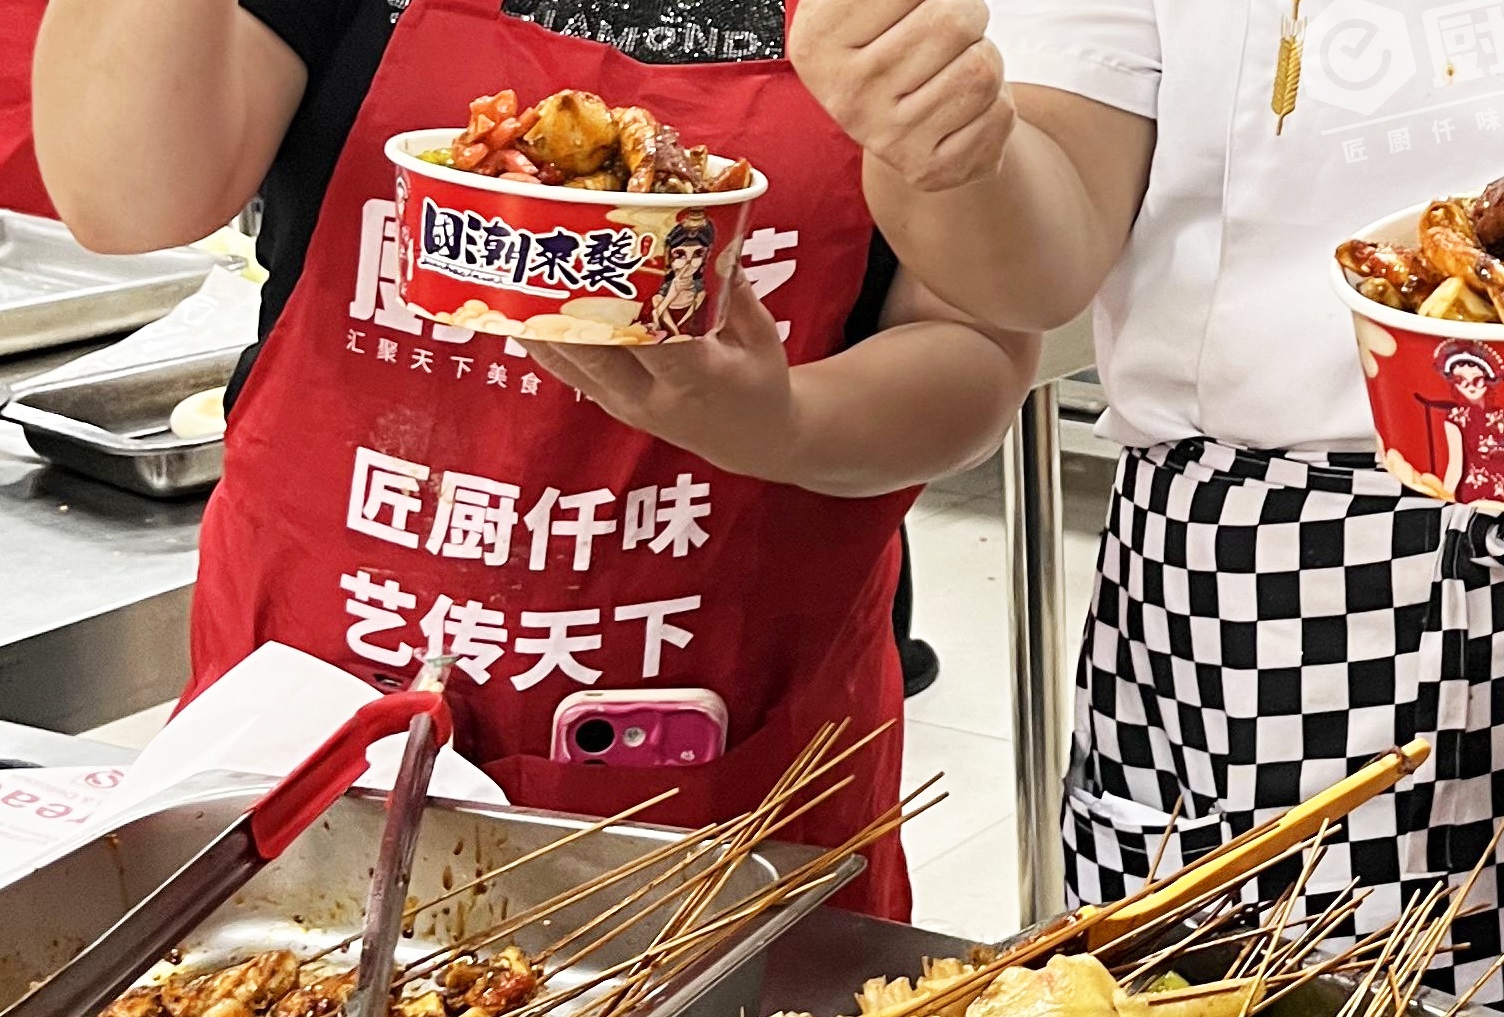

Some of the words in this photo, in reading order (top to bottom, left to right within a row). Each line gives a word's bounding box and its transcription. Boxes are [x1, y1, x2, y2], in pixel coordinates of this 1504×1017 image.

[346, 328, 543, 396] 汇聚天下美食
[345, 445, 712, 572] 匠厨仟味
[339, 569, 703, 692] 艺传天下
